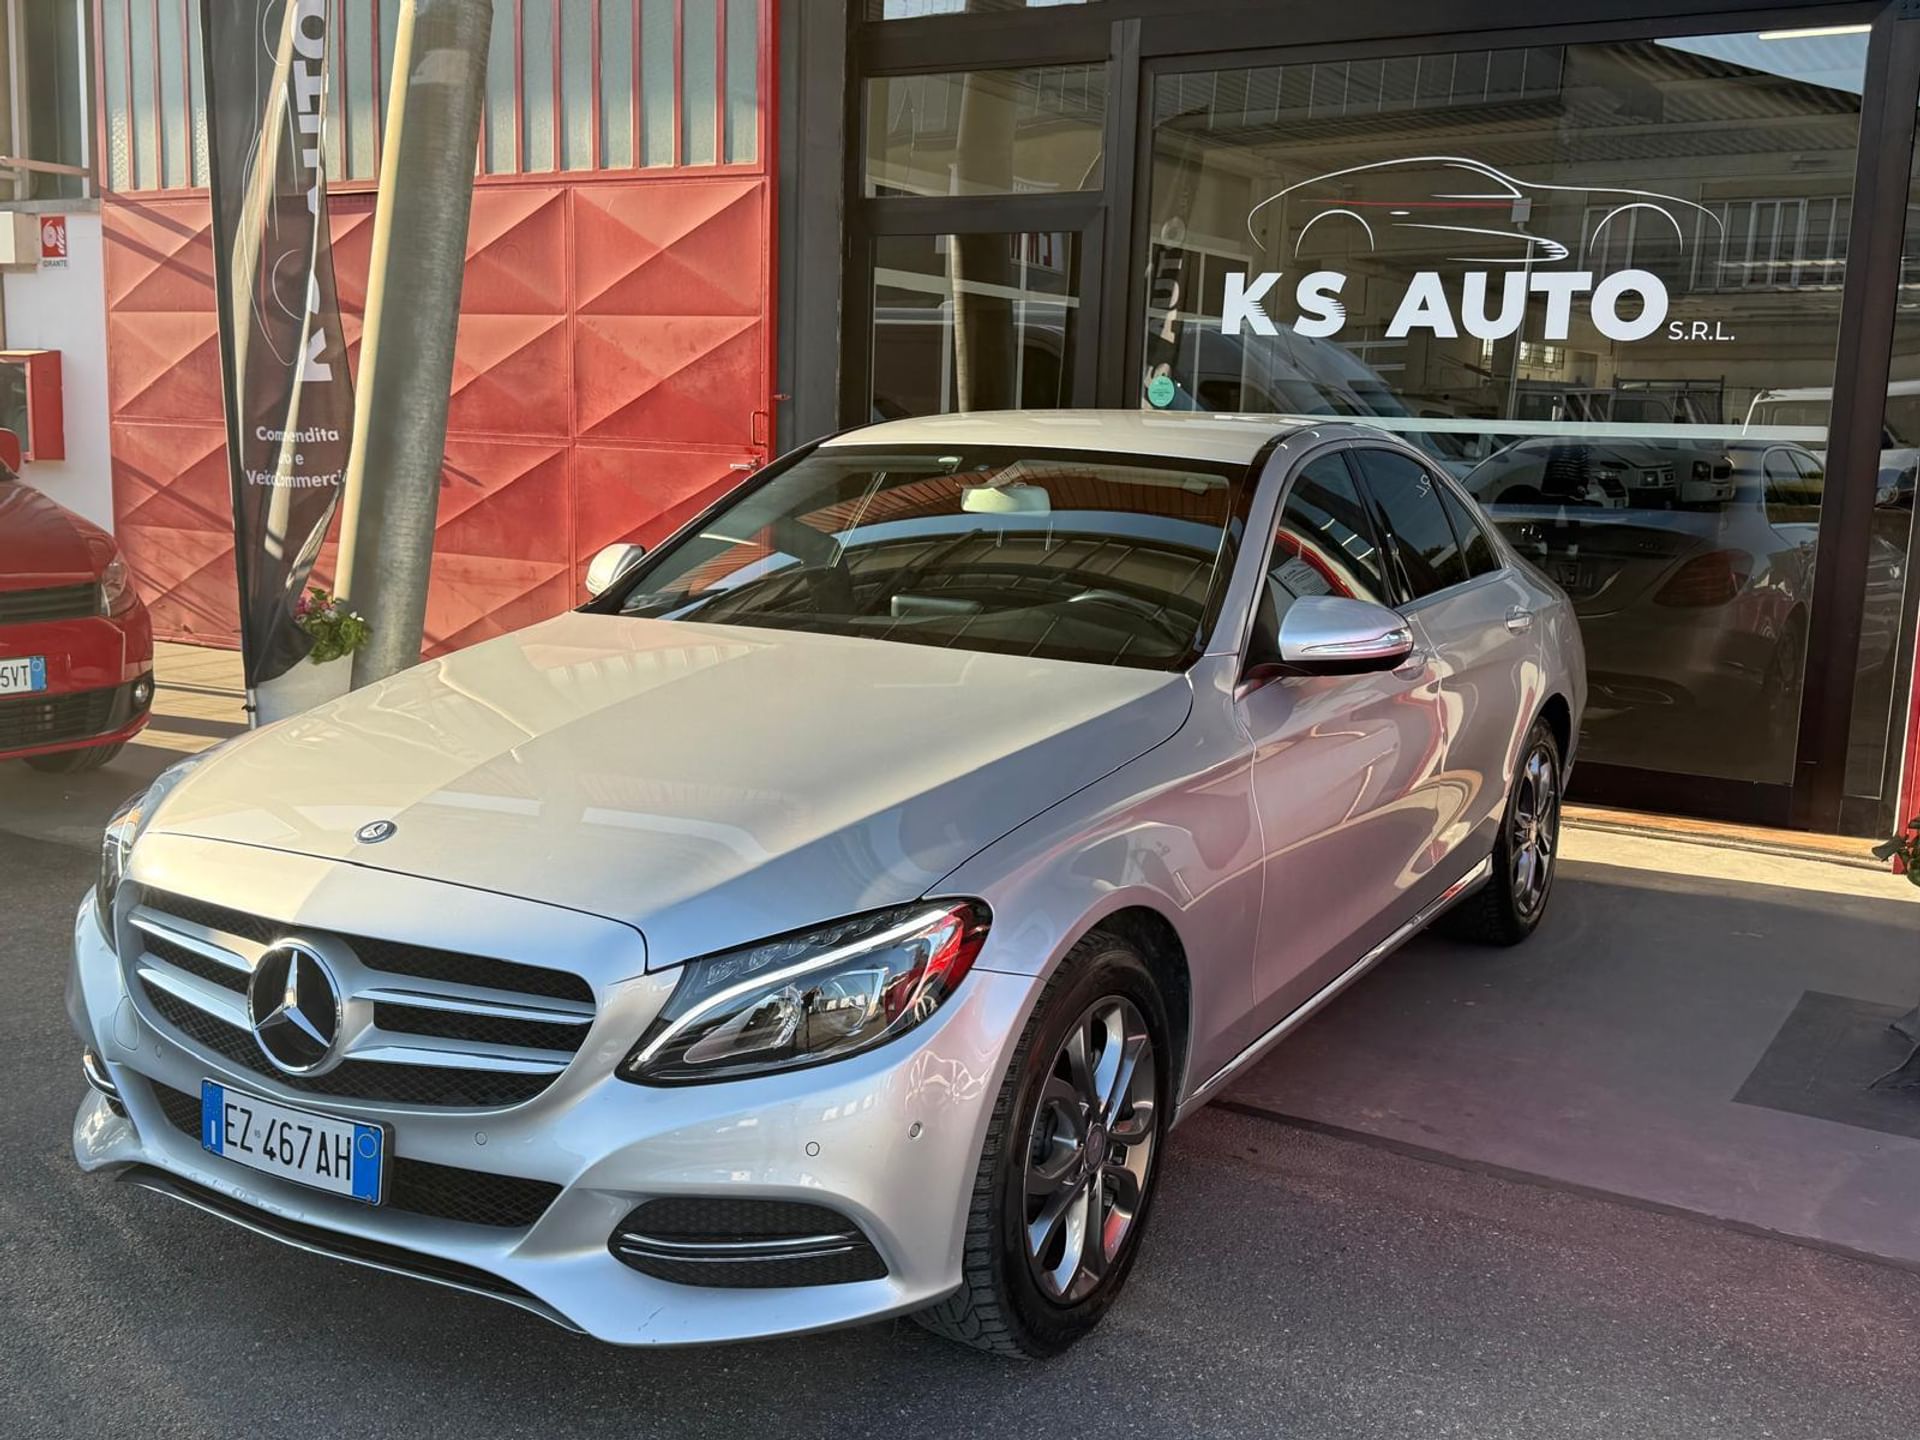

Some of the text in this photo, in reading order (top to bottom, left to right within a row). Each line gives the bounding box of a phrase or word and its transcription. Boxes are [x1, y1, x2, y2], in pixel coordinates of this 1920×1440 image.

[1221, 269, 1737, 342] KS AUTO S.R.L.
[224, 1103, 351, 1181] EZ 467AH
